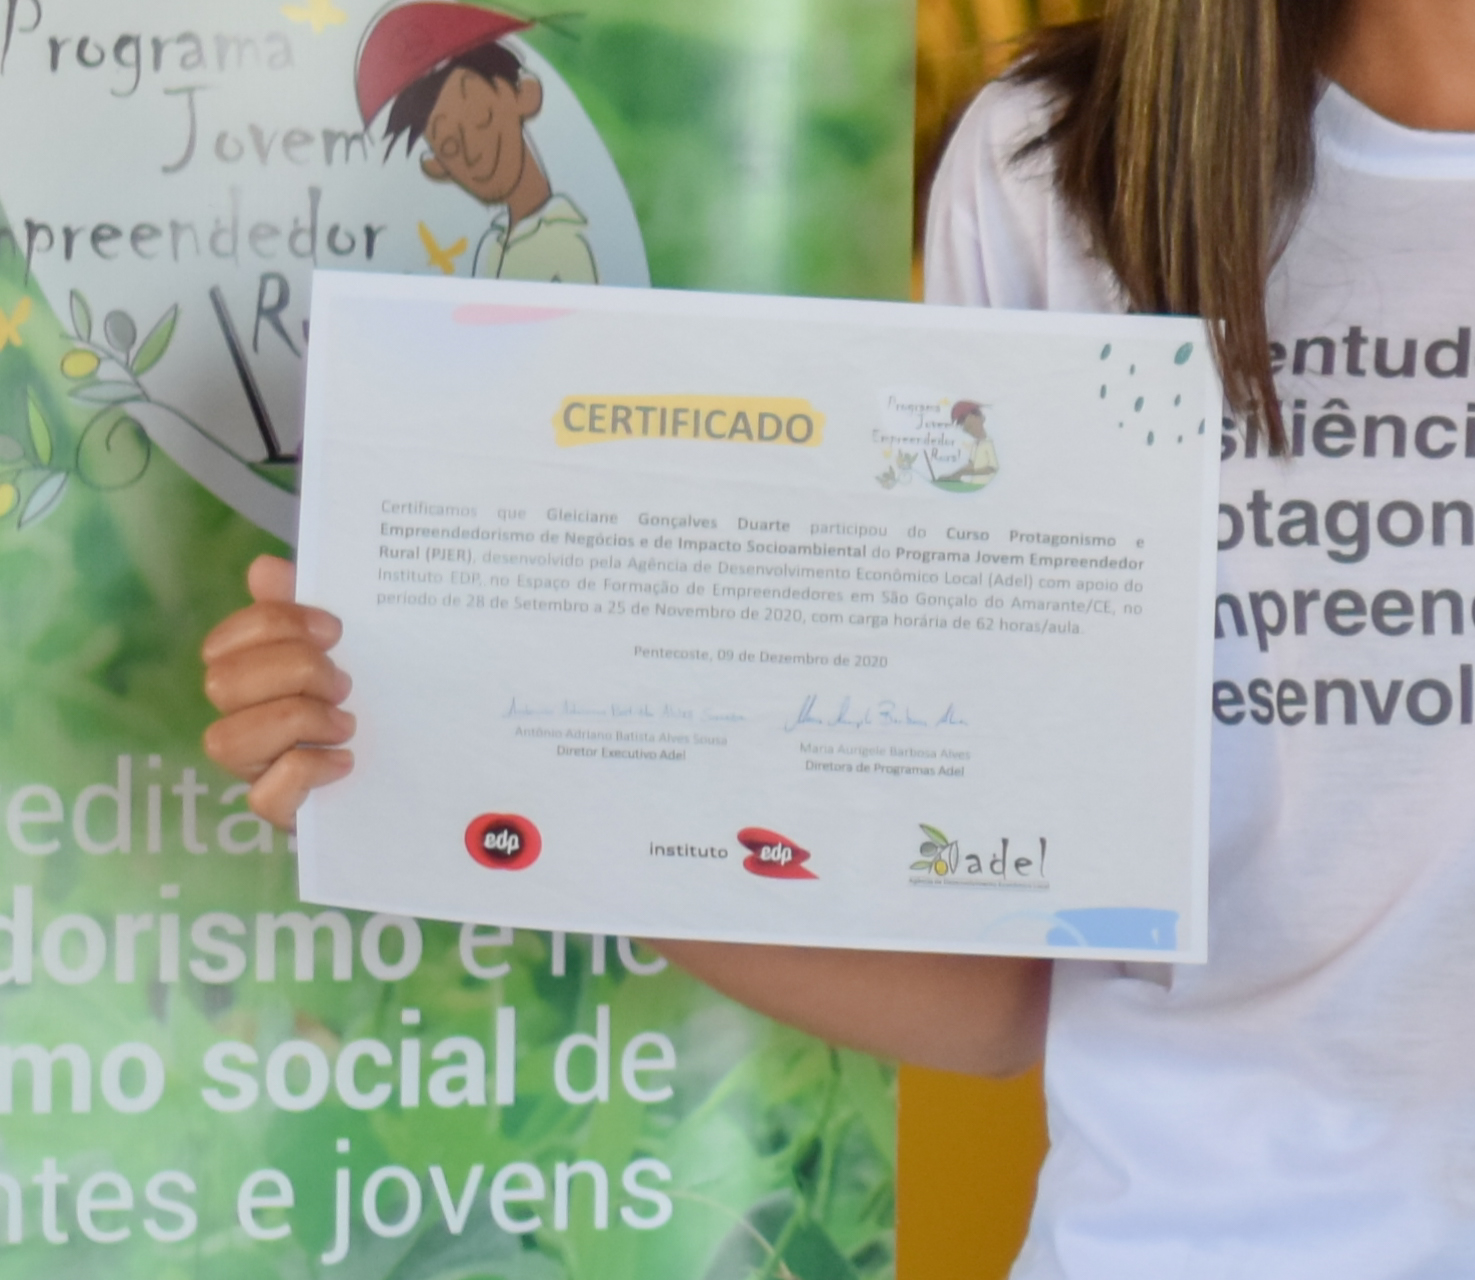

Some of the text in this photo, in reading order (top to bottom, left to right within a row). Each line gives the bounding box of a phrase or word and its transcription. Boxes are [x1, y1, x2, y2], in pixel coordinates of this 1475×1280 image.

[161, 84, 369, 174] Jovem
[0, 185, 388, 286] preendedor
[562, 400, 815, 446] CERTIFICADO
[380, 499, 478, 518] Certificamos
[496, 508, 527, 522] que
[737, 516, 791, 532] Duarte
[810, 522, 888, 539] participou
[906, 524, 927, 539] do
[946, 526, 990, 542] Curso
[1009, 529, 1117, 548] Protagonismo
[1135, 538, 1145, 549] e
[6, 754, 298, 856] edita
[201, 1006, 516, 1113] social
[552, 1005, 676, 1105] de
[236, 1167, 295, 1240] e
[322, 1138, 674, 1265] jovens
